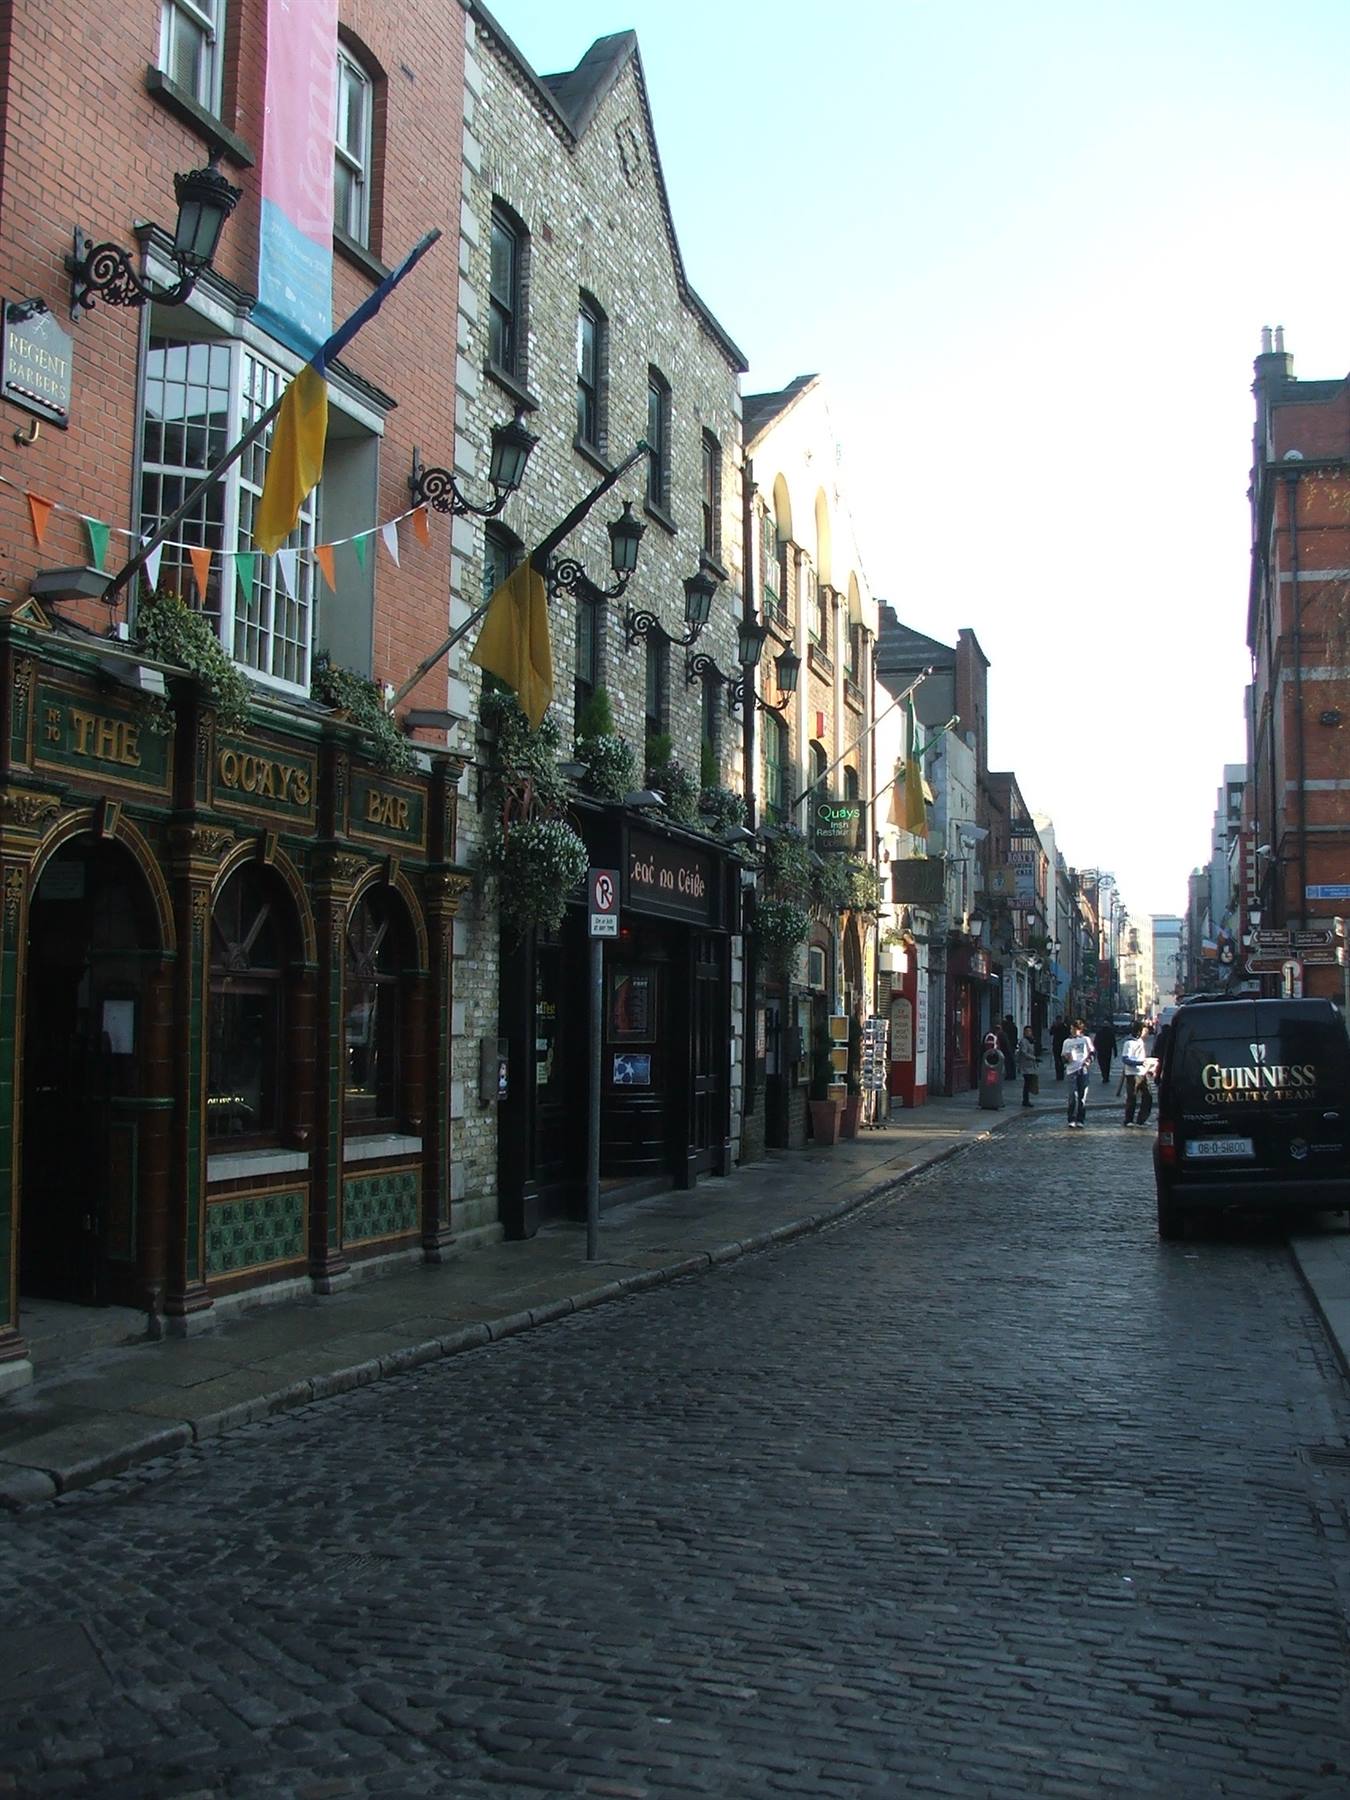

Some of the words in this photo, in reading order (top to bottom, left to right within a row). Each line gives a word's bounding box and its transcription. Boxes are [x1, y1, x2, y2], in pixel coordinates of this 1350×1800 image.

[9, 332, 68, 379] REGENT
[8, 358, 67, 401] BARBERS
[68, 707, 141, 767] THE
[365, 788, 410, 832] BAR
[817, 804, 861, 822] Quays
[660, 868, 674, 890] na
[1202, 1064, 1316, 1089] GUINNESS
[1204, 1091, 1269, 1105] QUALITY
[1274, 1090, 1316, 1101] TEAM
